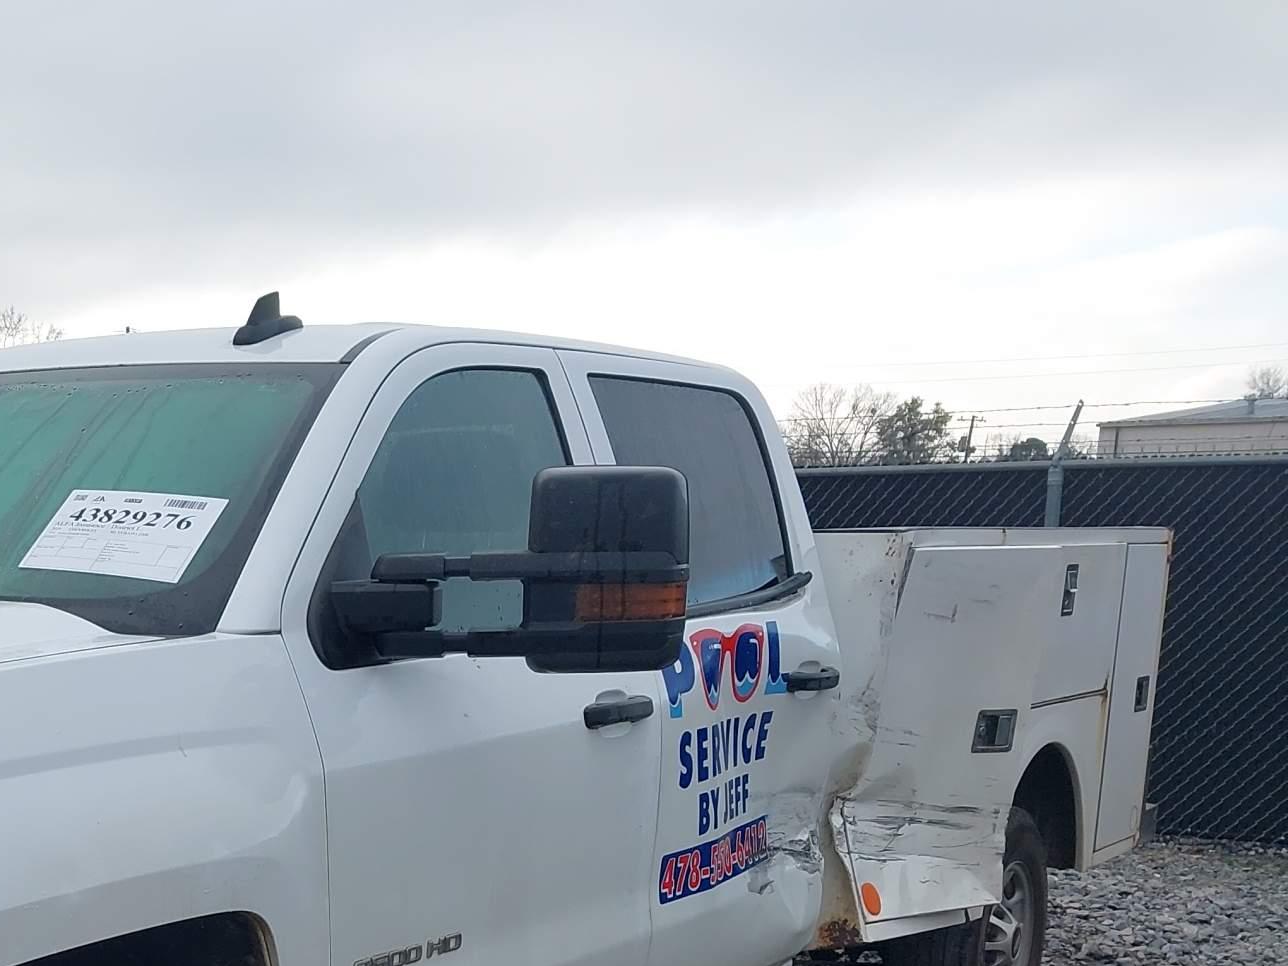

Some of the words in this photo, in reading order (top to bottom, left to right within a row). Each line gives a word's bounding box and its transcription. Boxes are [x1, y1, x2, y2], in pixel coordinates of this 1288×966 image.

[69, 507, 196, 531] 43829276
[679, 710, 774, 789] SERVICE
[698, 787, 721, 836] BY
[722, 774, 750, 826] JEFF
[426, 933, 463, 959] HD
